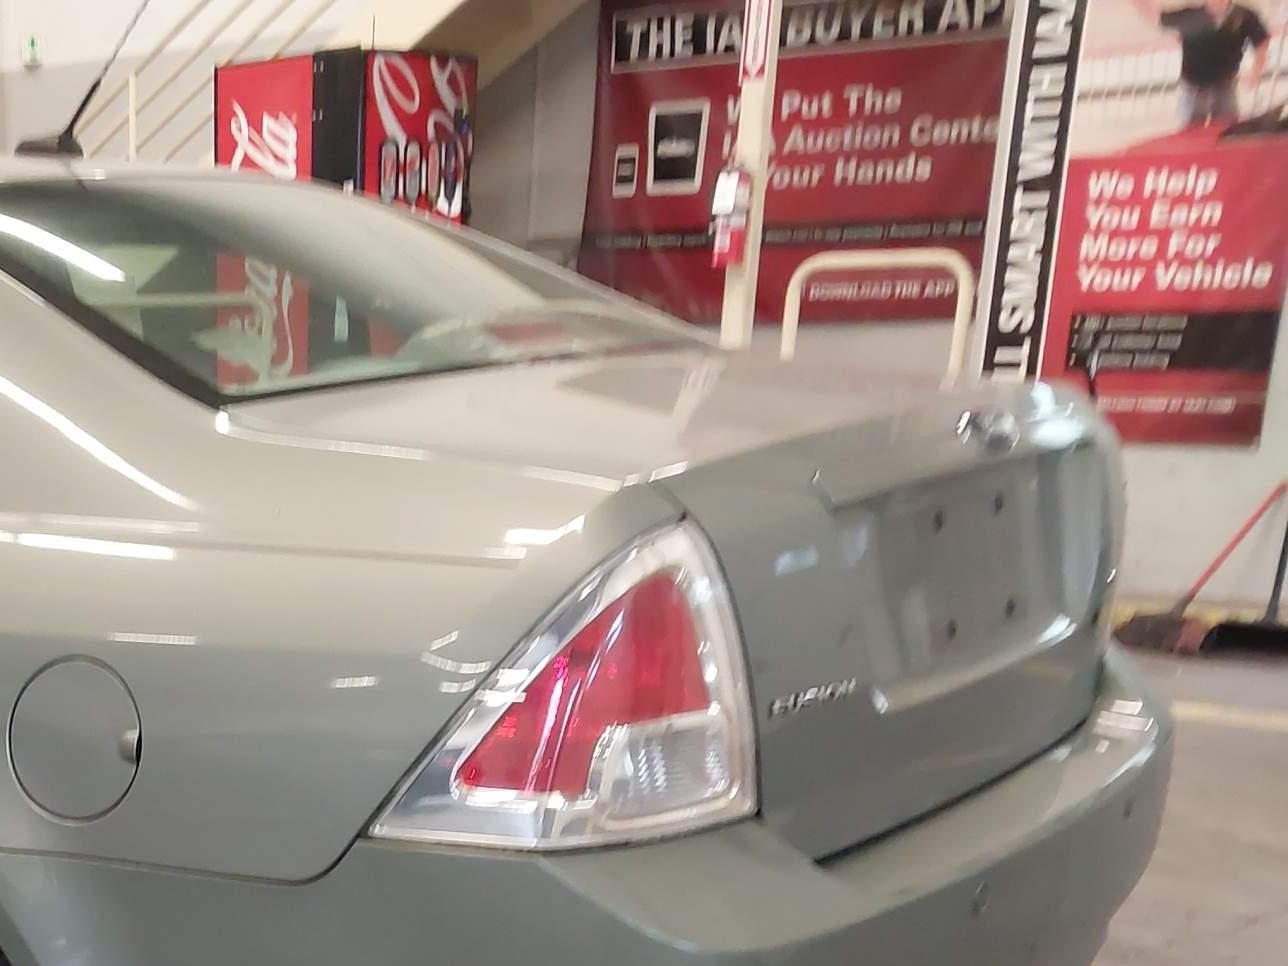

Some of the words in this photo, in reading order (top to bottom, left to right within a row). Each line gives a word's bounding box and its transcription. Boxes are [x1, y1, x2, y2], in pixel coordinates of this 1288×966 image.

[626, 12, 694, 63] THE
[706, 11, 743, 55] IA
[785, 0, 925, 47] BUYER
[780, 89, 833, 121] Put
[843, 83, 902, 117] The
[782, 122, 900, 155] Auction
[910, 113, 1000, 147] Cente
[1015, 62, 1068, 183] WITH
[834, 151, 933, 188] Hands
[1088, 168, 1134, 201] We
[1143, 163, 1219, 200] Help
[1086, 201, 1141, 231] You
[1149, 198, 1224, 230] Earn
[998, 183, 1051, 334] SMART
[1079, 231, 1159, 262] More
[1166, 228, 1222, 260] For
[1077, 260, 1147, 292] Your
[1154, 256, 1273, 291] Vehicle
